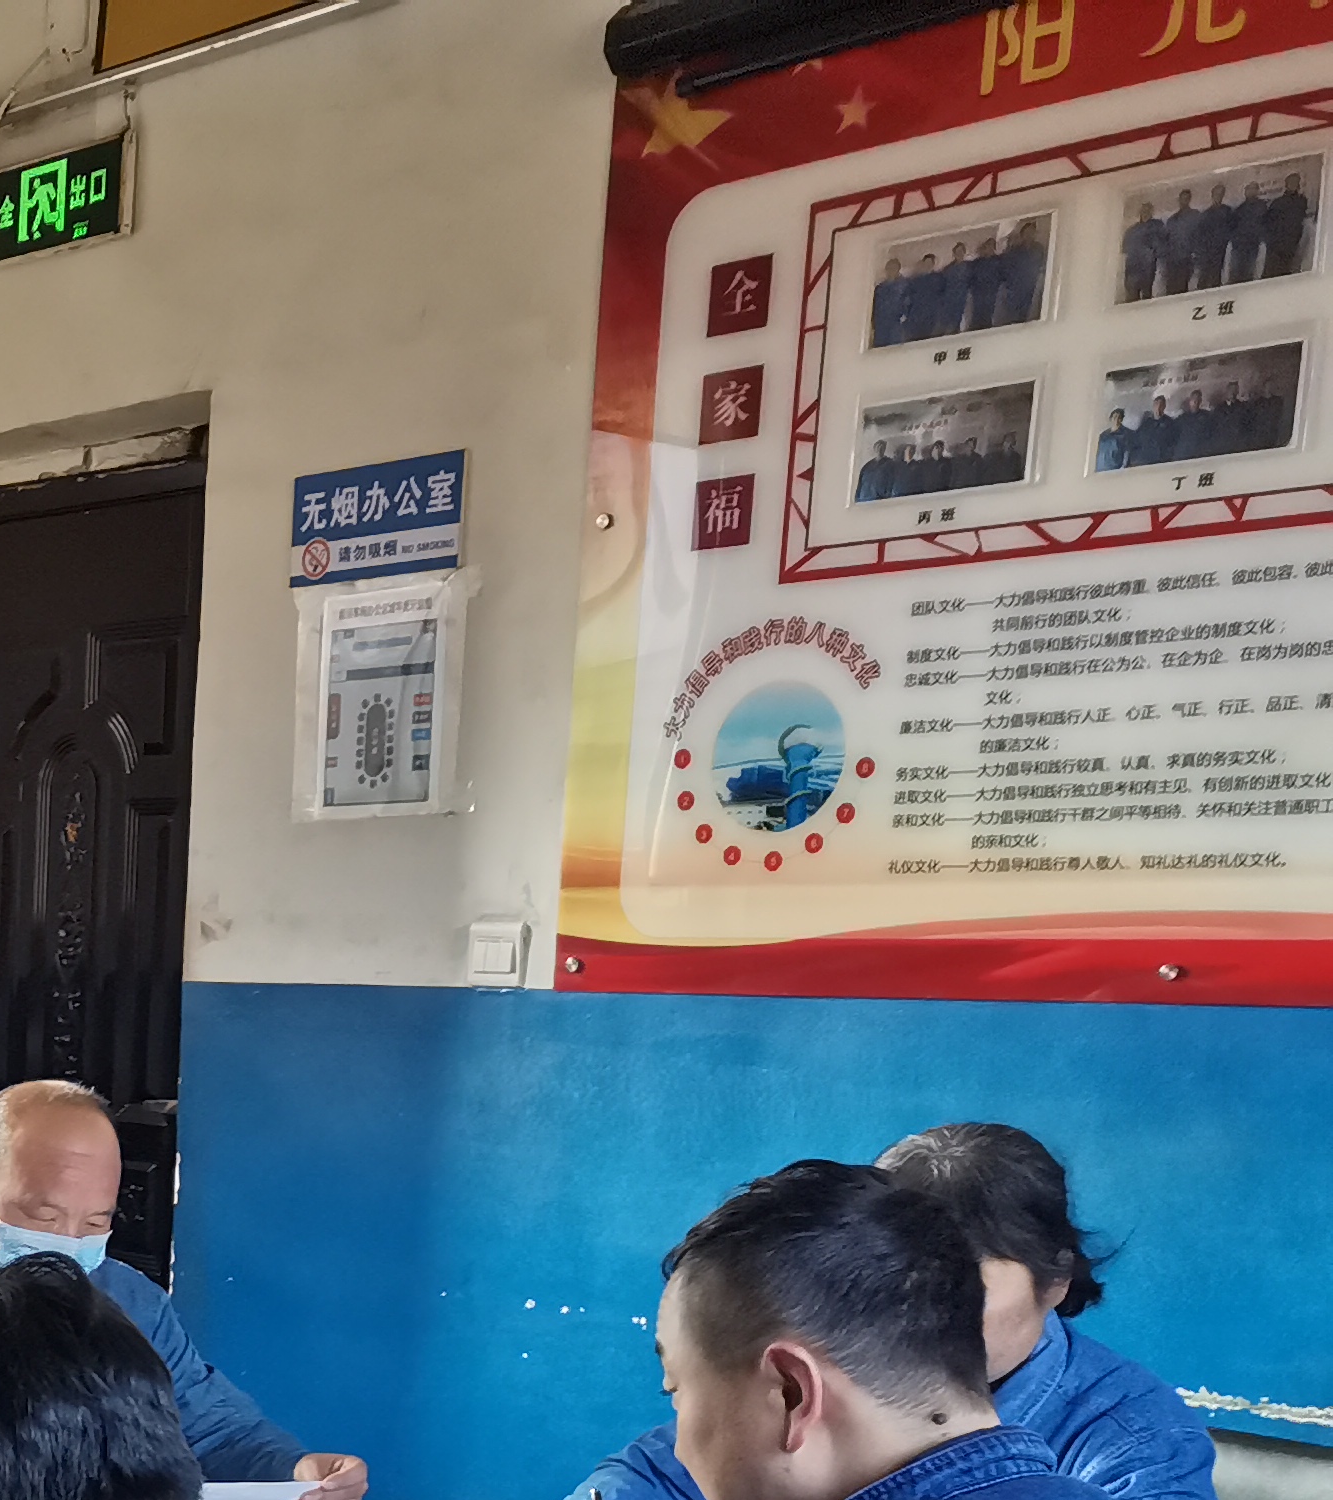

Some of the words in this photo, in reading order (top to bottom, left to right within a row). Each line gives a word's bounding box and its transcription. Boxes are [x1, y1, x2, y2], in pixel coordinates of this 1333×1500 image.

[69, 168, 107, 210] 出口
[1191, 300, 1236, 321] 乙班
[933, 346, 972, 365] 甲班
[703, 269, 761, 537] 全家福
[1171, 471, 1216, 490] 丁班
[299, 469, 457, 533] 无烟办公室
[338, 539, 399, 563] 请勿吸烟
[663, 615, 882, 742] 大力倡导和践行的八种文化
